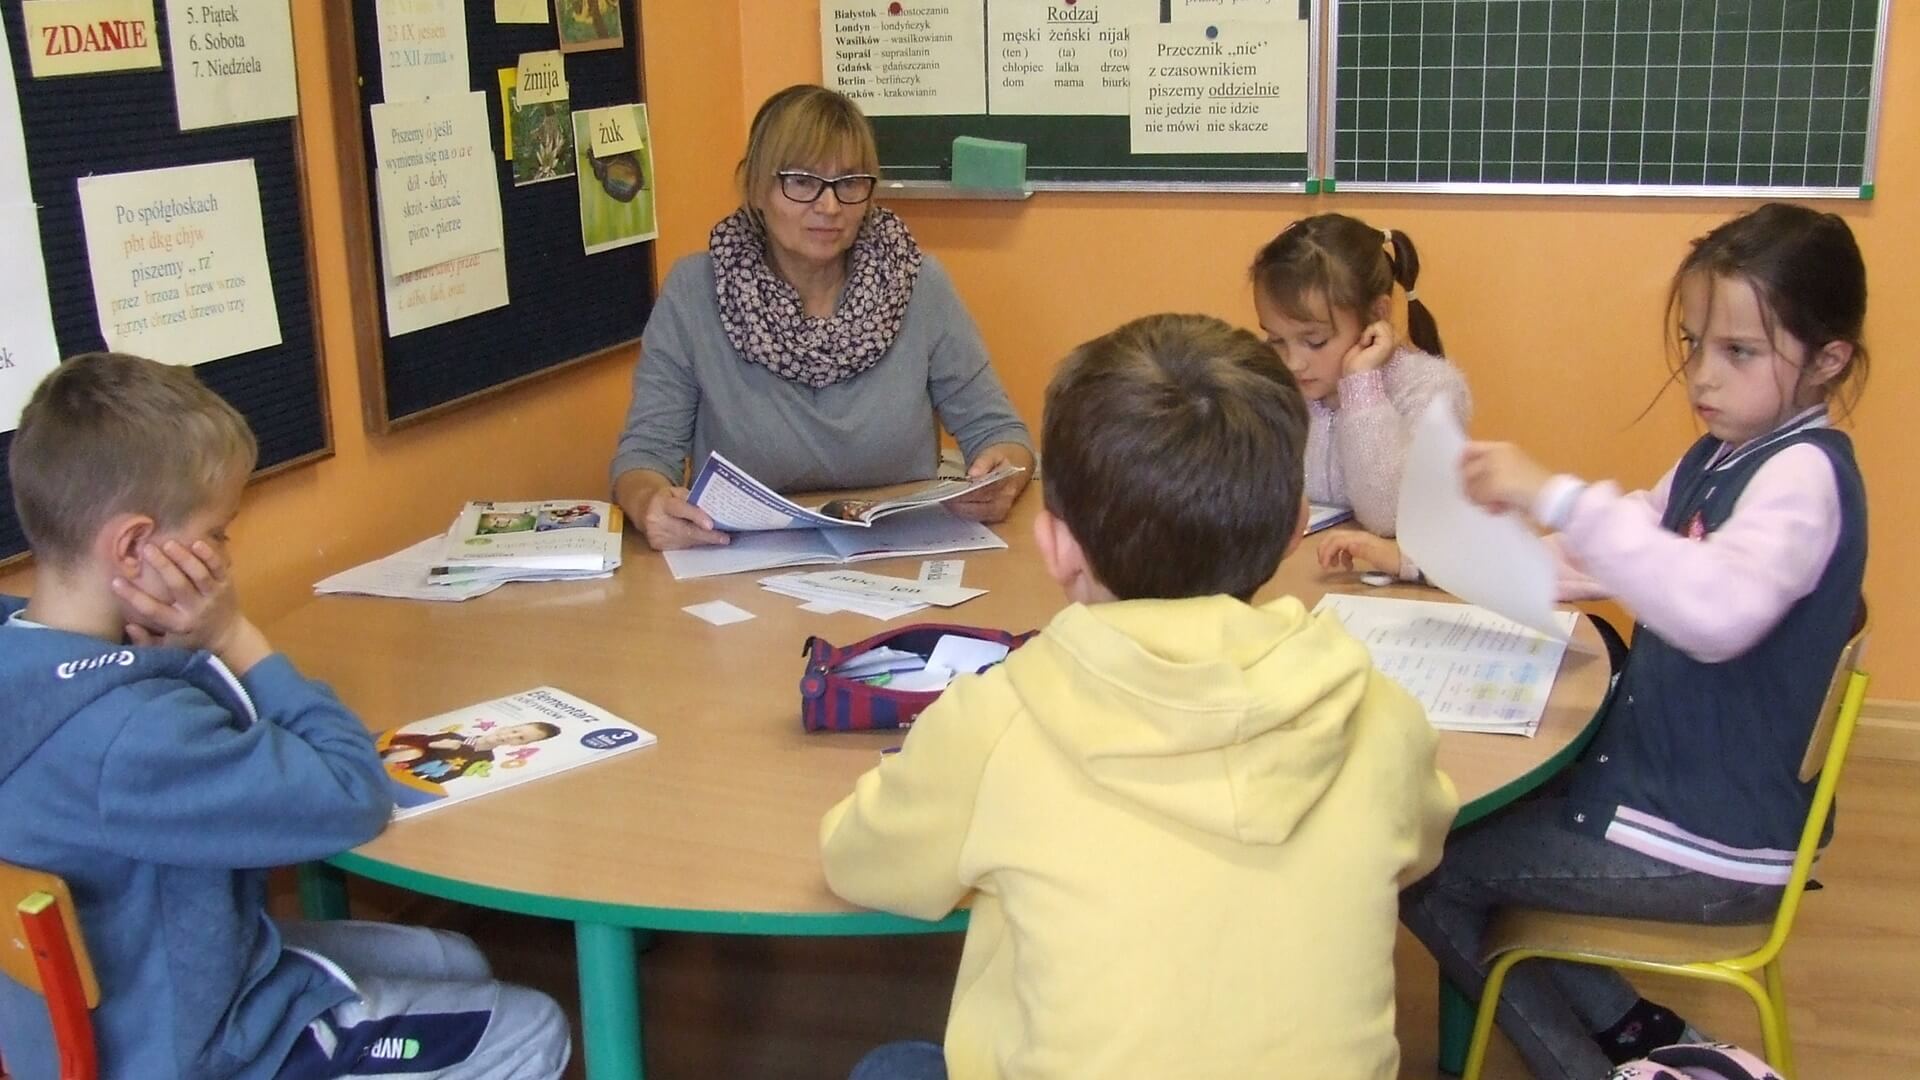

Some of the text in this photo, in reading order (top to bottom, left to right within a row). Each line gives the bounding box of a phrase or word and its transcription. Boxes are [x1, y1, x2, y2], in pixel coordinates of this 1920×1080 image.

[203, 5, 239, 27] Piątek
[834, 9, 877, 21] Białystok
[1047, 5, 1099, 24] Rodzaj
[835, 23, 871, 34] Londyn
[1002, 28, 1041, 44] męski
[1048, 27, 1090, 41] żeński
[42, 20, 147, 56] ZDANIE
[205, 32, 245, 50] Sobota
[835, 36, 880, 46] Wasilków
[890, 33, 953, 44] wasilkowianin
[836, 49, 871, 61] Supraśl
[881, 47, 930, 60] supraślanin
[1058, 47, 1076, 58] (ta)
[1109, 47, 1128, 58] (to)
[1157, 42, 1223, 57] Przecznik
[207, 56, 262, 77] Niedziela
[836, 63, 872, 73] Gdańsk
[882, 60, 940, 73] gdańszczanin
[1002, 62, 1044, 75] chłopiec
[1055, 62, 1079, 73] lalka
[1148, 62, 1257, 77] z czasownikiem
[523, 63, 559, 96] żmija
[838, 76, 866, 86] Berlin
[875, 74, 921, 87] berlińczyk
[1002, 77, 1024, 87] dom
[883, 88, 937, 98] krakowianin
[1149, 82, 1280, 100] piszemy oddzielnie
[1145, 102, 1259, 118] nie jedzie nie idzie
[599, 118, 624, 144] żuk
[1145, 120, 1269, 132] nie mówi nie skacze
[116, 193, 219, 226] Po spółgłoskach
[131, 262, 185, 288] piszemy
[527, 690, 600, 724] Elementarz
